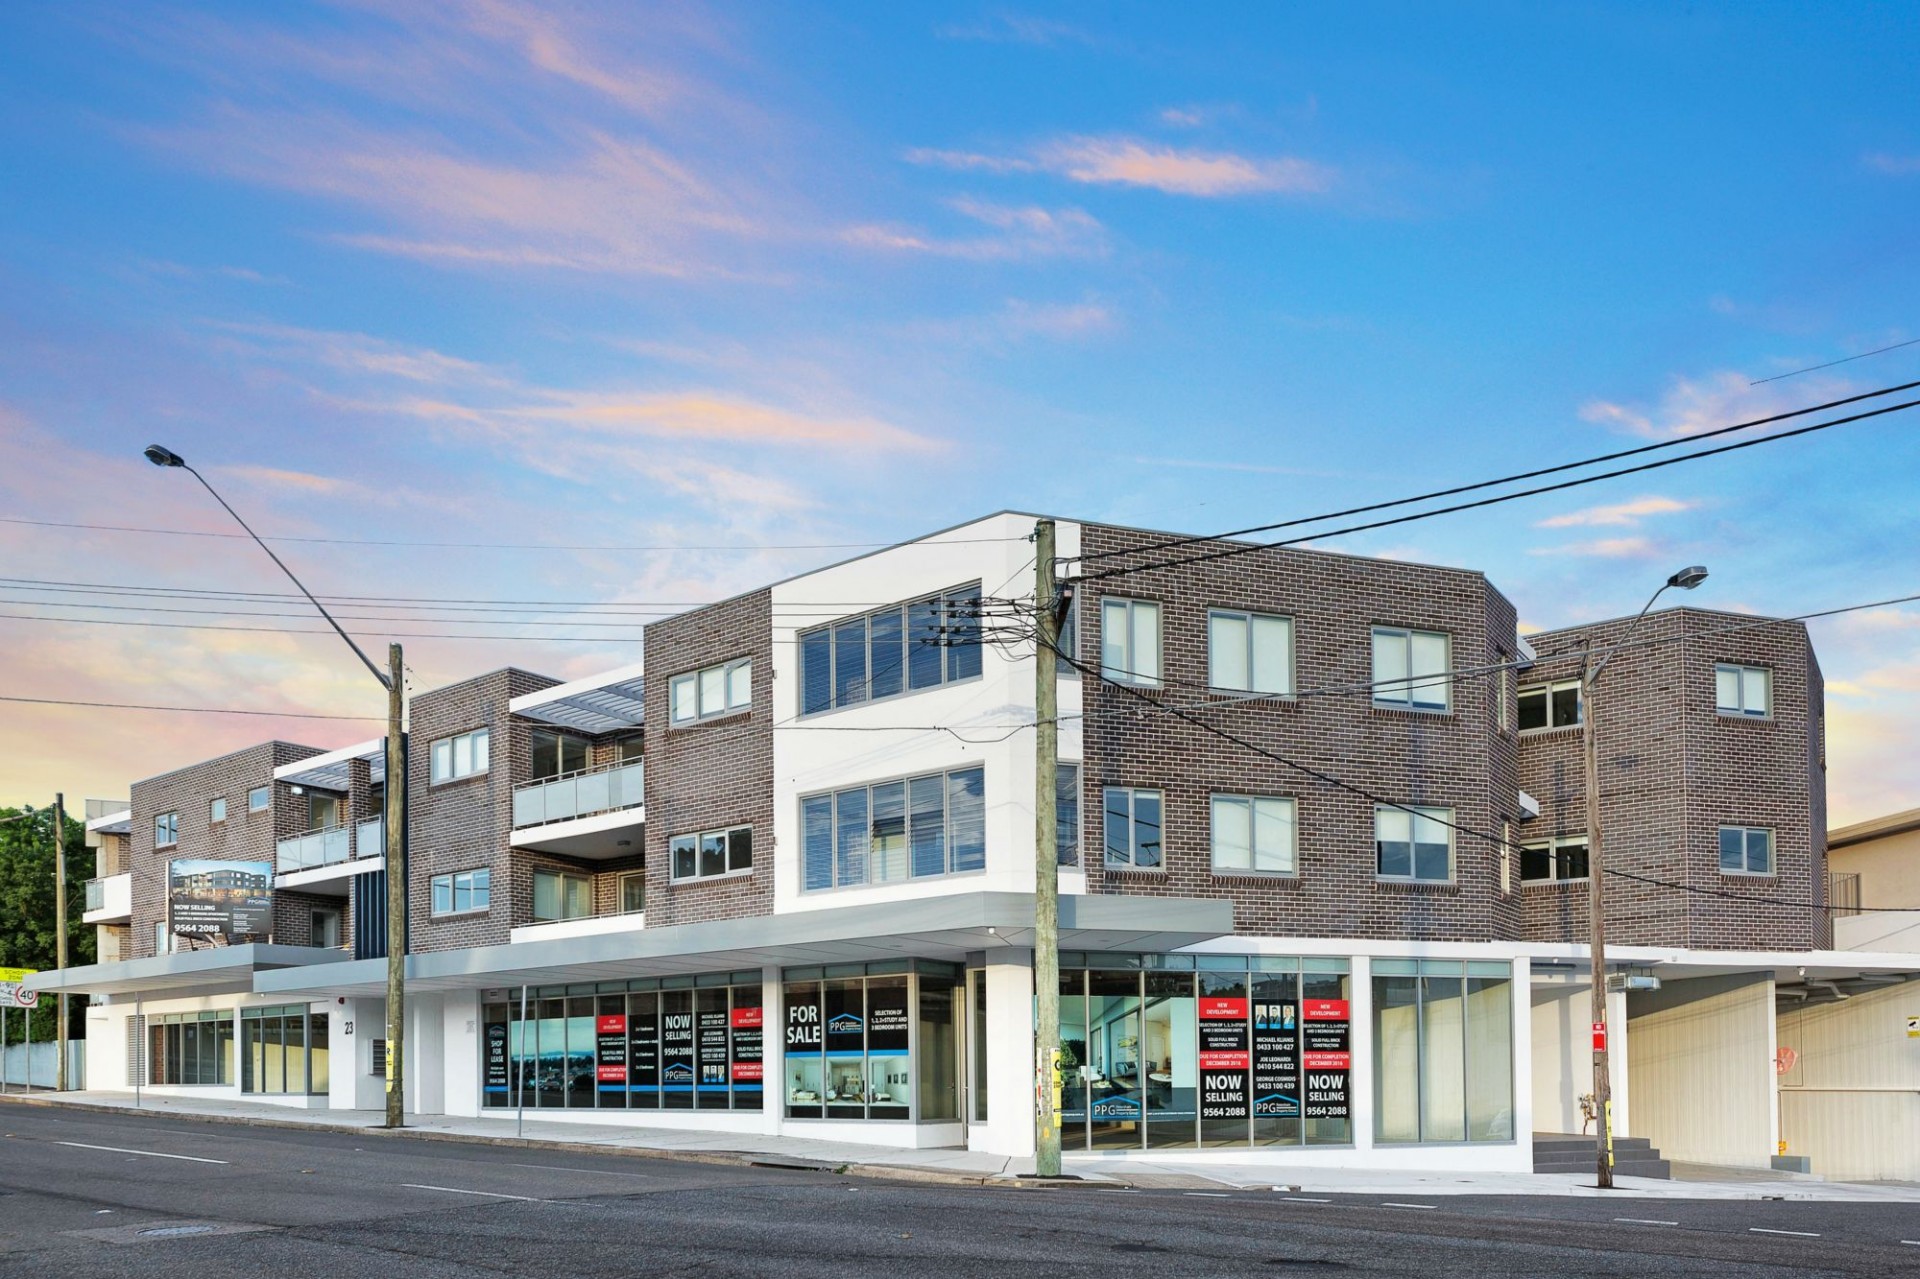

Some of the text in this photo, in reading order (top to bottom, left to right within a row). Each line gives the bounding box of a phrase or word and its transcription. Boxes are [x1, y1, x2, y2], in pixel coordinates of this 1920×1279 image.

[174, 924, 220, 932] 9564 2088
[20, 990, 34, 1000] 40
[789, 1005, 817, 1023] FOR
[665, 1014, 691, 1029] NOW
[830, 1021, 845, 1032] PPG
[344, 1021, 353, 1035] 23
[665, 1031, 692, 1040] SELLING
[786, 1025, 821, 1044] SALE
[490, 1040, 503, 1048] SHOP
[664, 1048, 678, 1056] 9564
[679, 1047, 693, 1056] 2088
[490, 1055, 503, 1063] LEASE
[665, 1070, 679, 1080] PPG
[1205, 1074, 1242, 1090] NOW
[1309, 1074, 1344, 1089] NOW
[1205, 1092, 1243, 1102] SELLING
[1309, 1091, 1345, 1101] SELLING
[1094, 1104, 1116, 1116] PPG
[1203, 1107, 1224, 1117] 9564
[1225, 1107, 1246, 1116] 2088
[1256, 1102, 1276, 1113] PPG
[1306, 1106, 1347, 1115] 9564 2088
